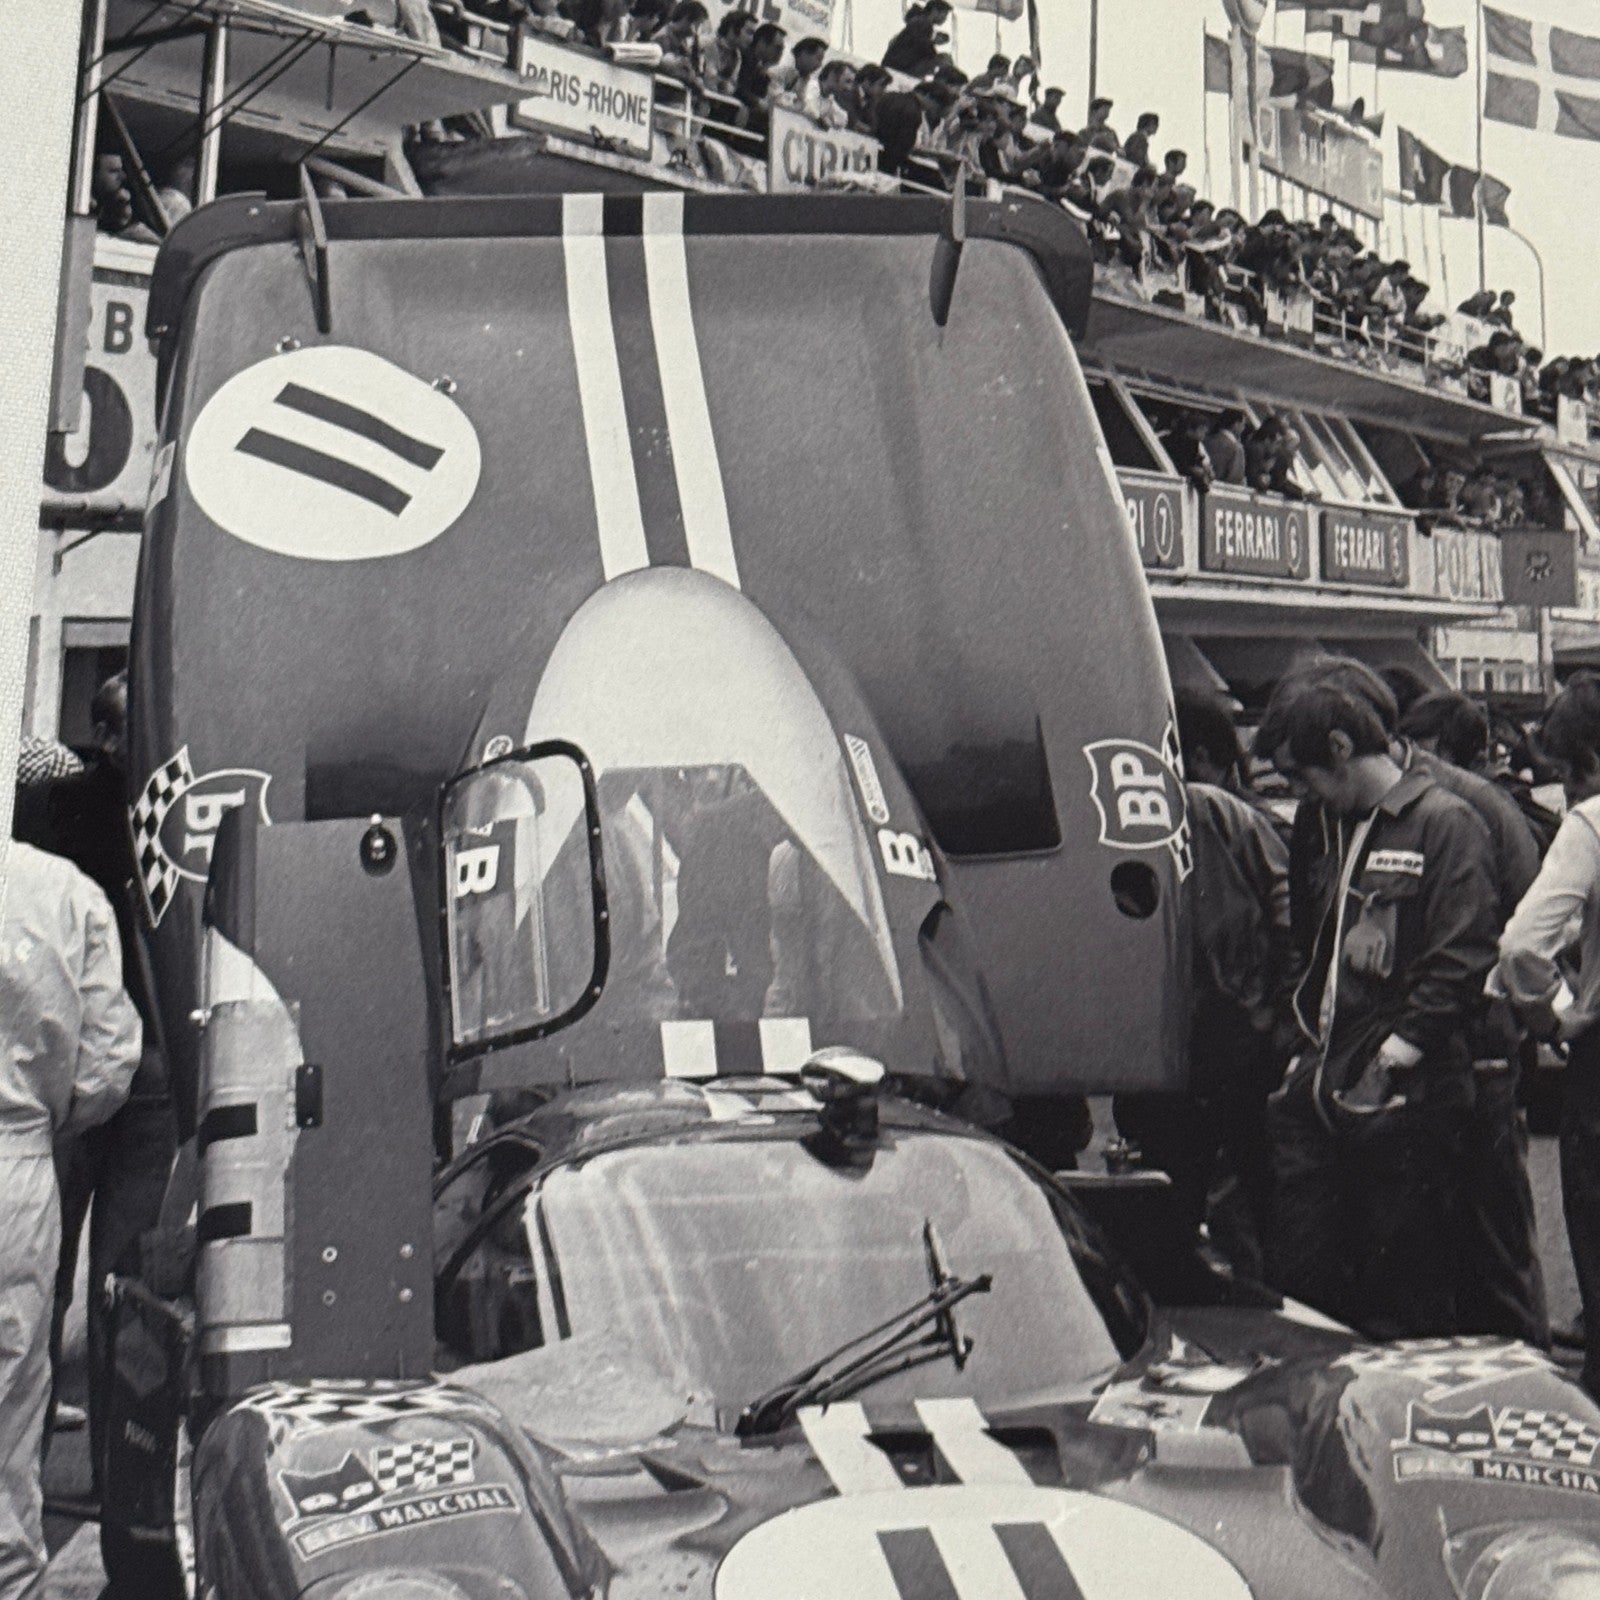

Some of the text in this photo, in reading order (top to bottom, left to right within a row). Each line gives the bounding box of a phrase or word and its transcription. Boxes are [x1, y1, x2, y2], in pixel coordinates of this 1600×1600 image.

[1214, 508, 1280, 561] FERRARI
[1334, 523, 1386, 571] FERRARI
[1111, 752, 1173, 832] BP
[379, 1489, 509, 1528] MARCHAL
